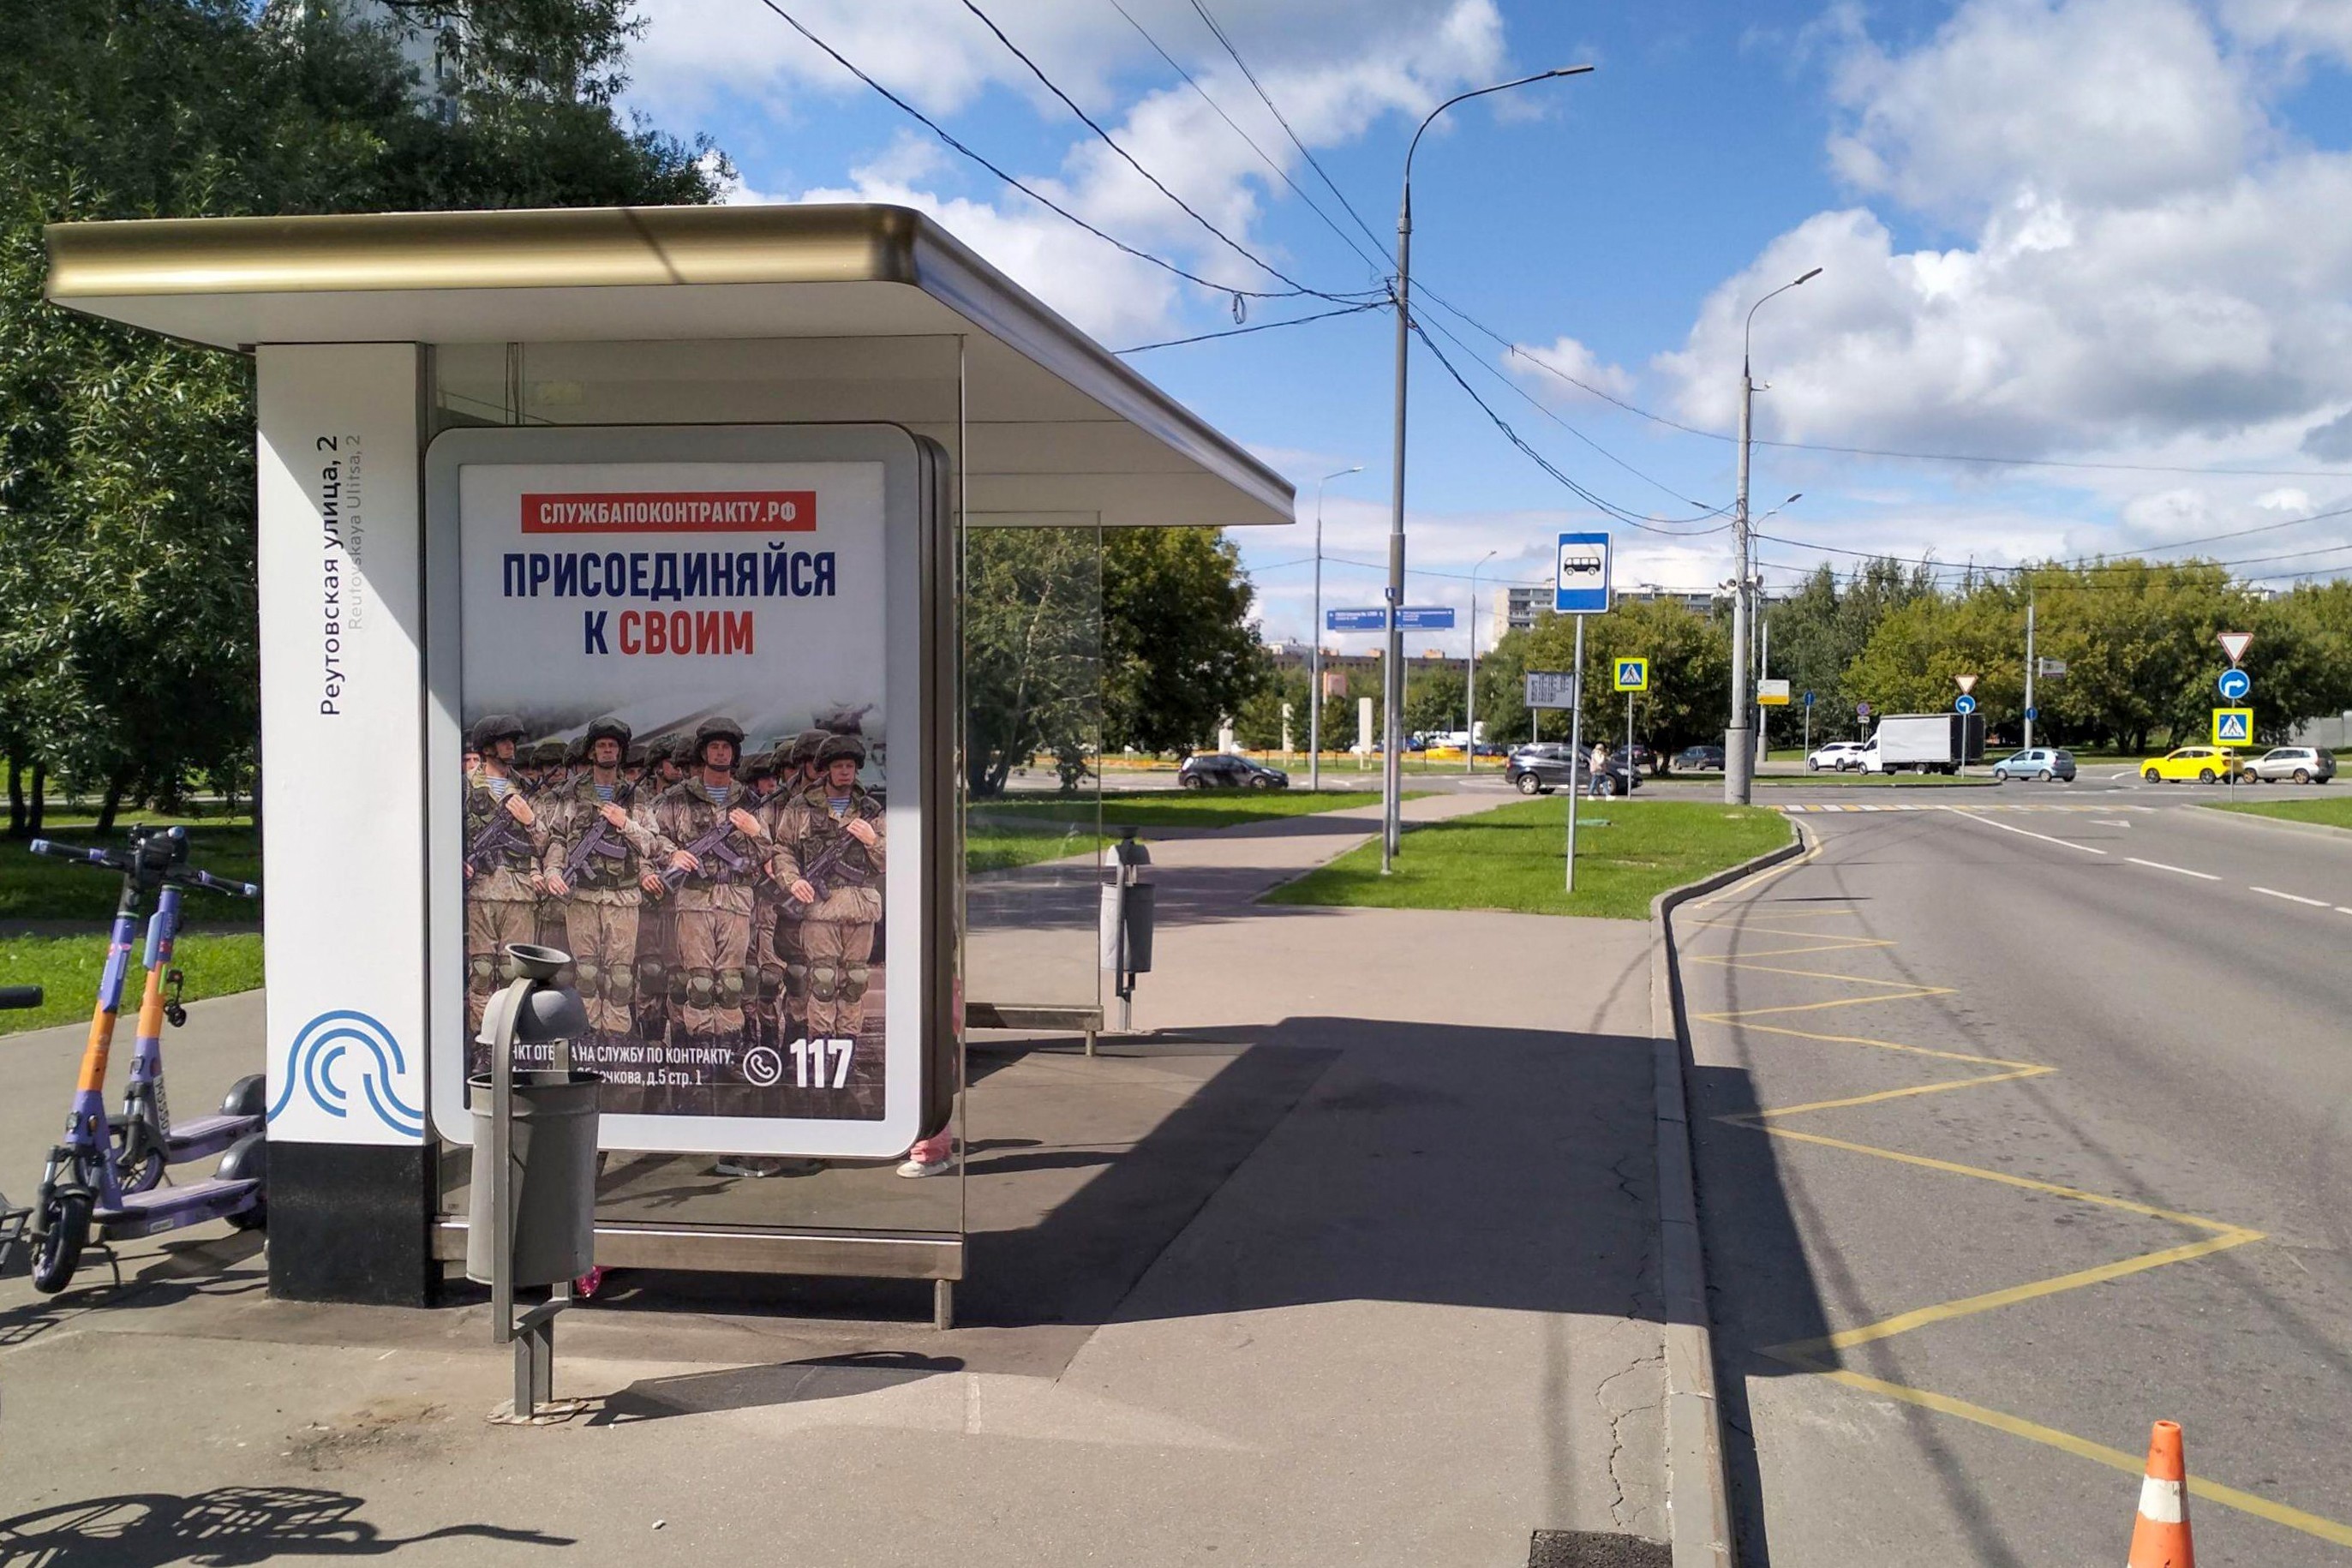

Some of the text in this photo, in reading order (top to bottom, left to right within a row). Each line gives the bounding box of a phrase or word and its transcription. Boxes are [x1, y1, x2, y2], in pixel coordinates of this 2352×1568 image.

[346, 434, 365, 630] Reutovskaya Ulitsa, 2
[540, 501, 796, 524] СЛУЖБАПОКОНТРАКТУ.РФ
[316, 435, 345, 715] Реутовская улица, 2
[503, 541, 836, 601] ПРИСОЕДИНЯЙСЯ
[584, 609, 754, 655] К СВОИМ
[579, 1046, 595, 1062] НА
[597, 1046, 643, 1064] СЛУЖБУ
[647, 1047, 663, 1062] ПО
[666, 1046, 735, 1065] КОНТРАКТУ:
[668, 1073, 692, 1087] стр.
[696, 1069, 703, 1085] 1
[789, 1038, 853, 1089] 117
